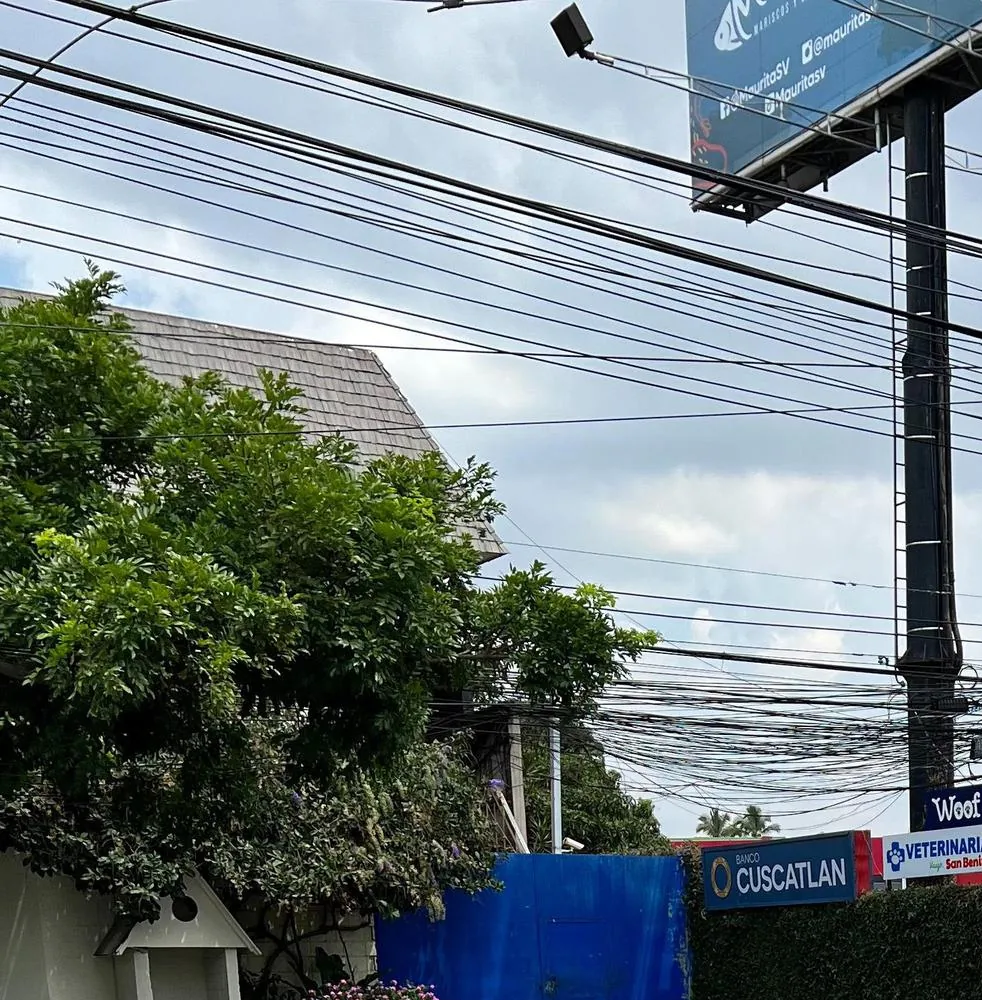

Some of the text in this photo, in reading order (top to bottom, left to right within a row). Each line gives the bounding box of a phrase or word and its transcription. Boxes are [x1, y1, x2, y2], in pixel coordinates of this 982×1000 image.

[753, 1, 790, 37] MARISCOS
[931, 791, 981, 822] Woof
[735, 852, 760, 865] BANCO
[945, 858, 962, 870] San
[736, 858, 846, 895] CUSCATLAN
